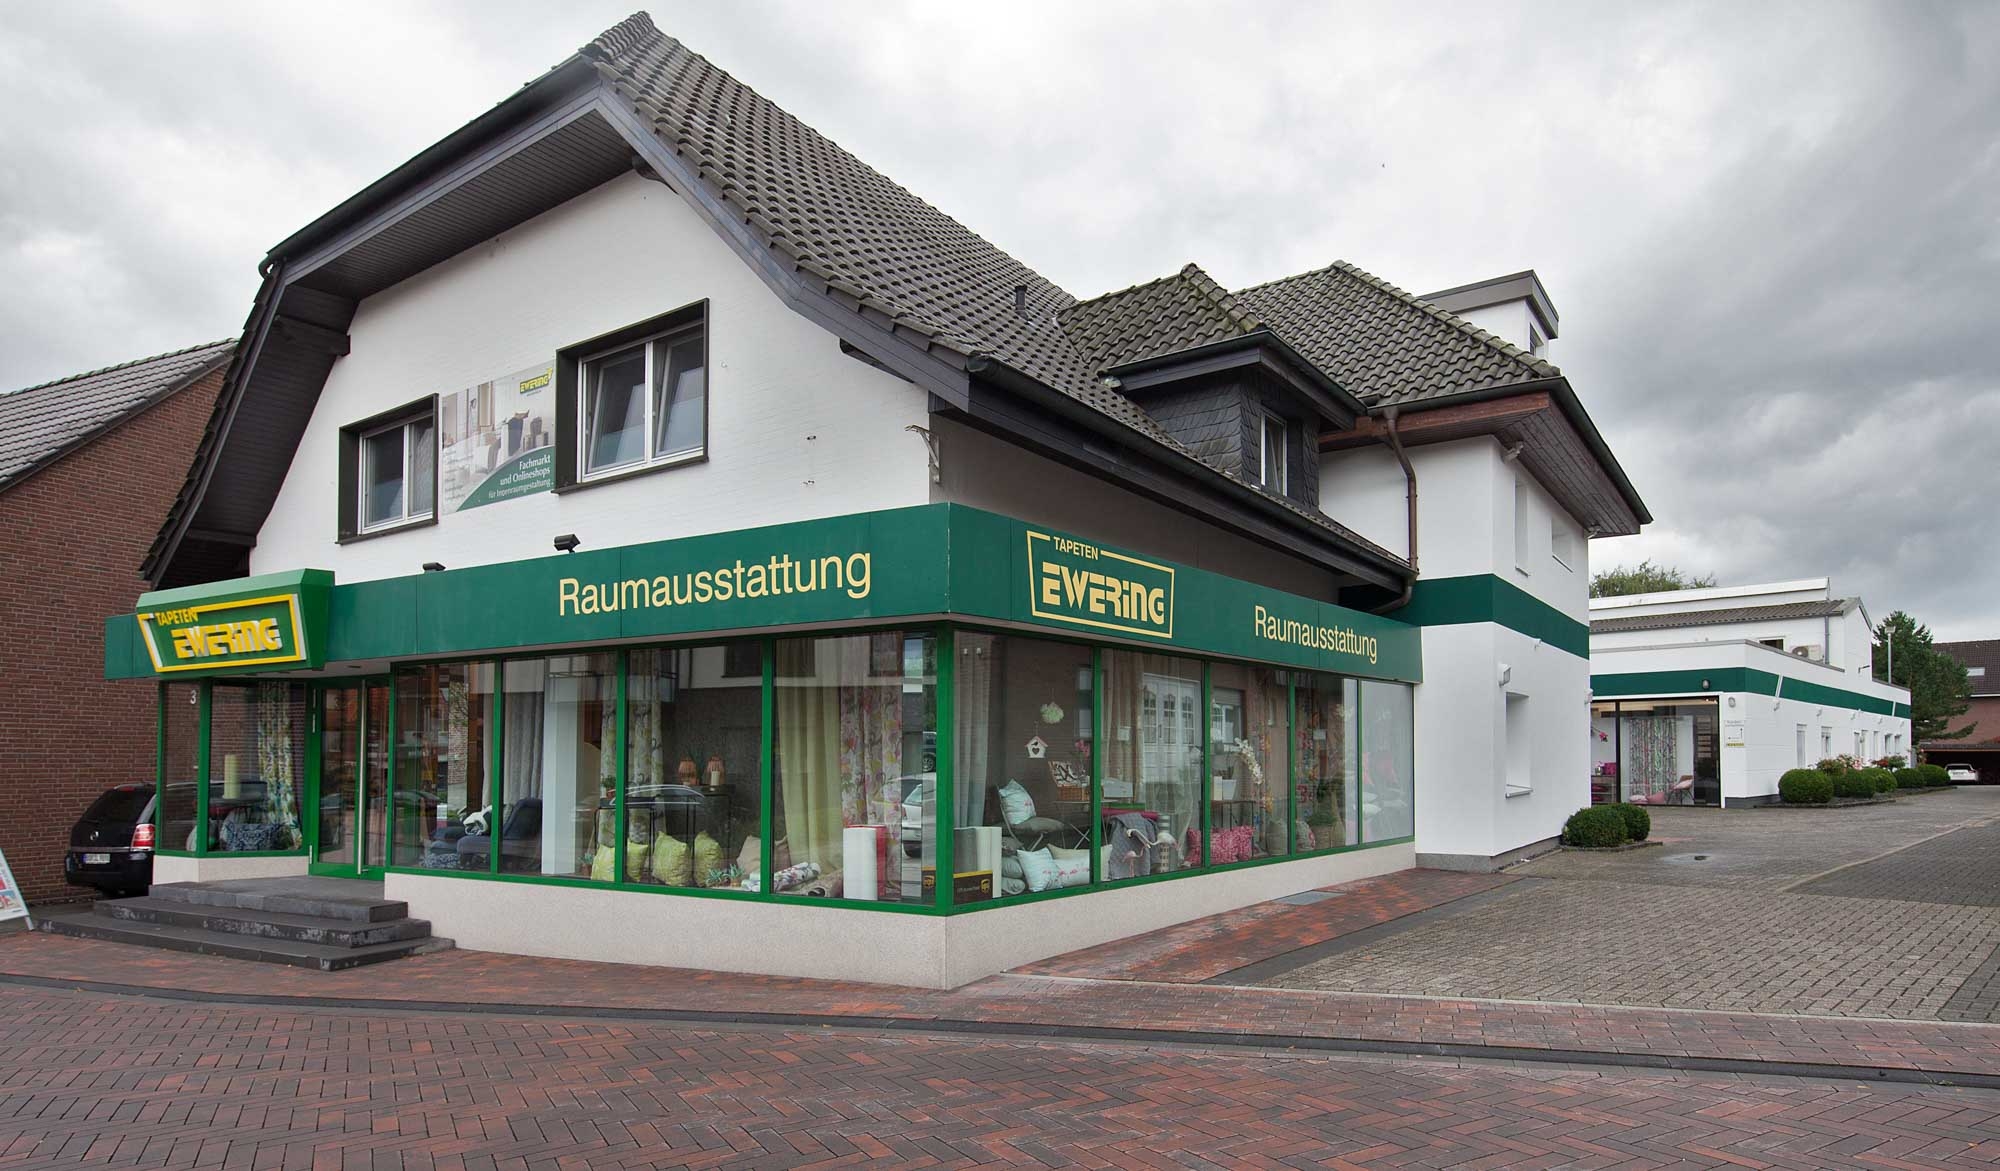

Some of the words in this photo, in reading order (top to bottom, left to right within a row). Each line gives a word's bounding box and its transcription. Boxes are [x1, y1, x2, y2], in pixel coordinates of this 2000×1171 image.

[519, 454, 551, 470] Fachmarkt
[500, 473, 512, 485] und
[512, 467, 551, 482] Onlineshops
[1053, 536, 1098, 560] TAPETEN
[559, 552, 871, 617] Raumausstattung
[155, 608, 199, 626] TAPETEN
[1255, 605, 1377, 665] Raumausstattung
[189, 689, 197, 705] 3
